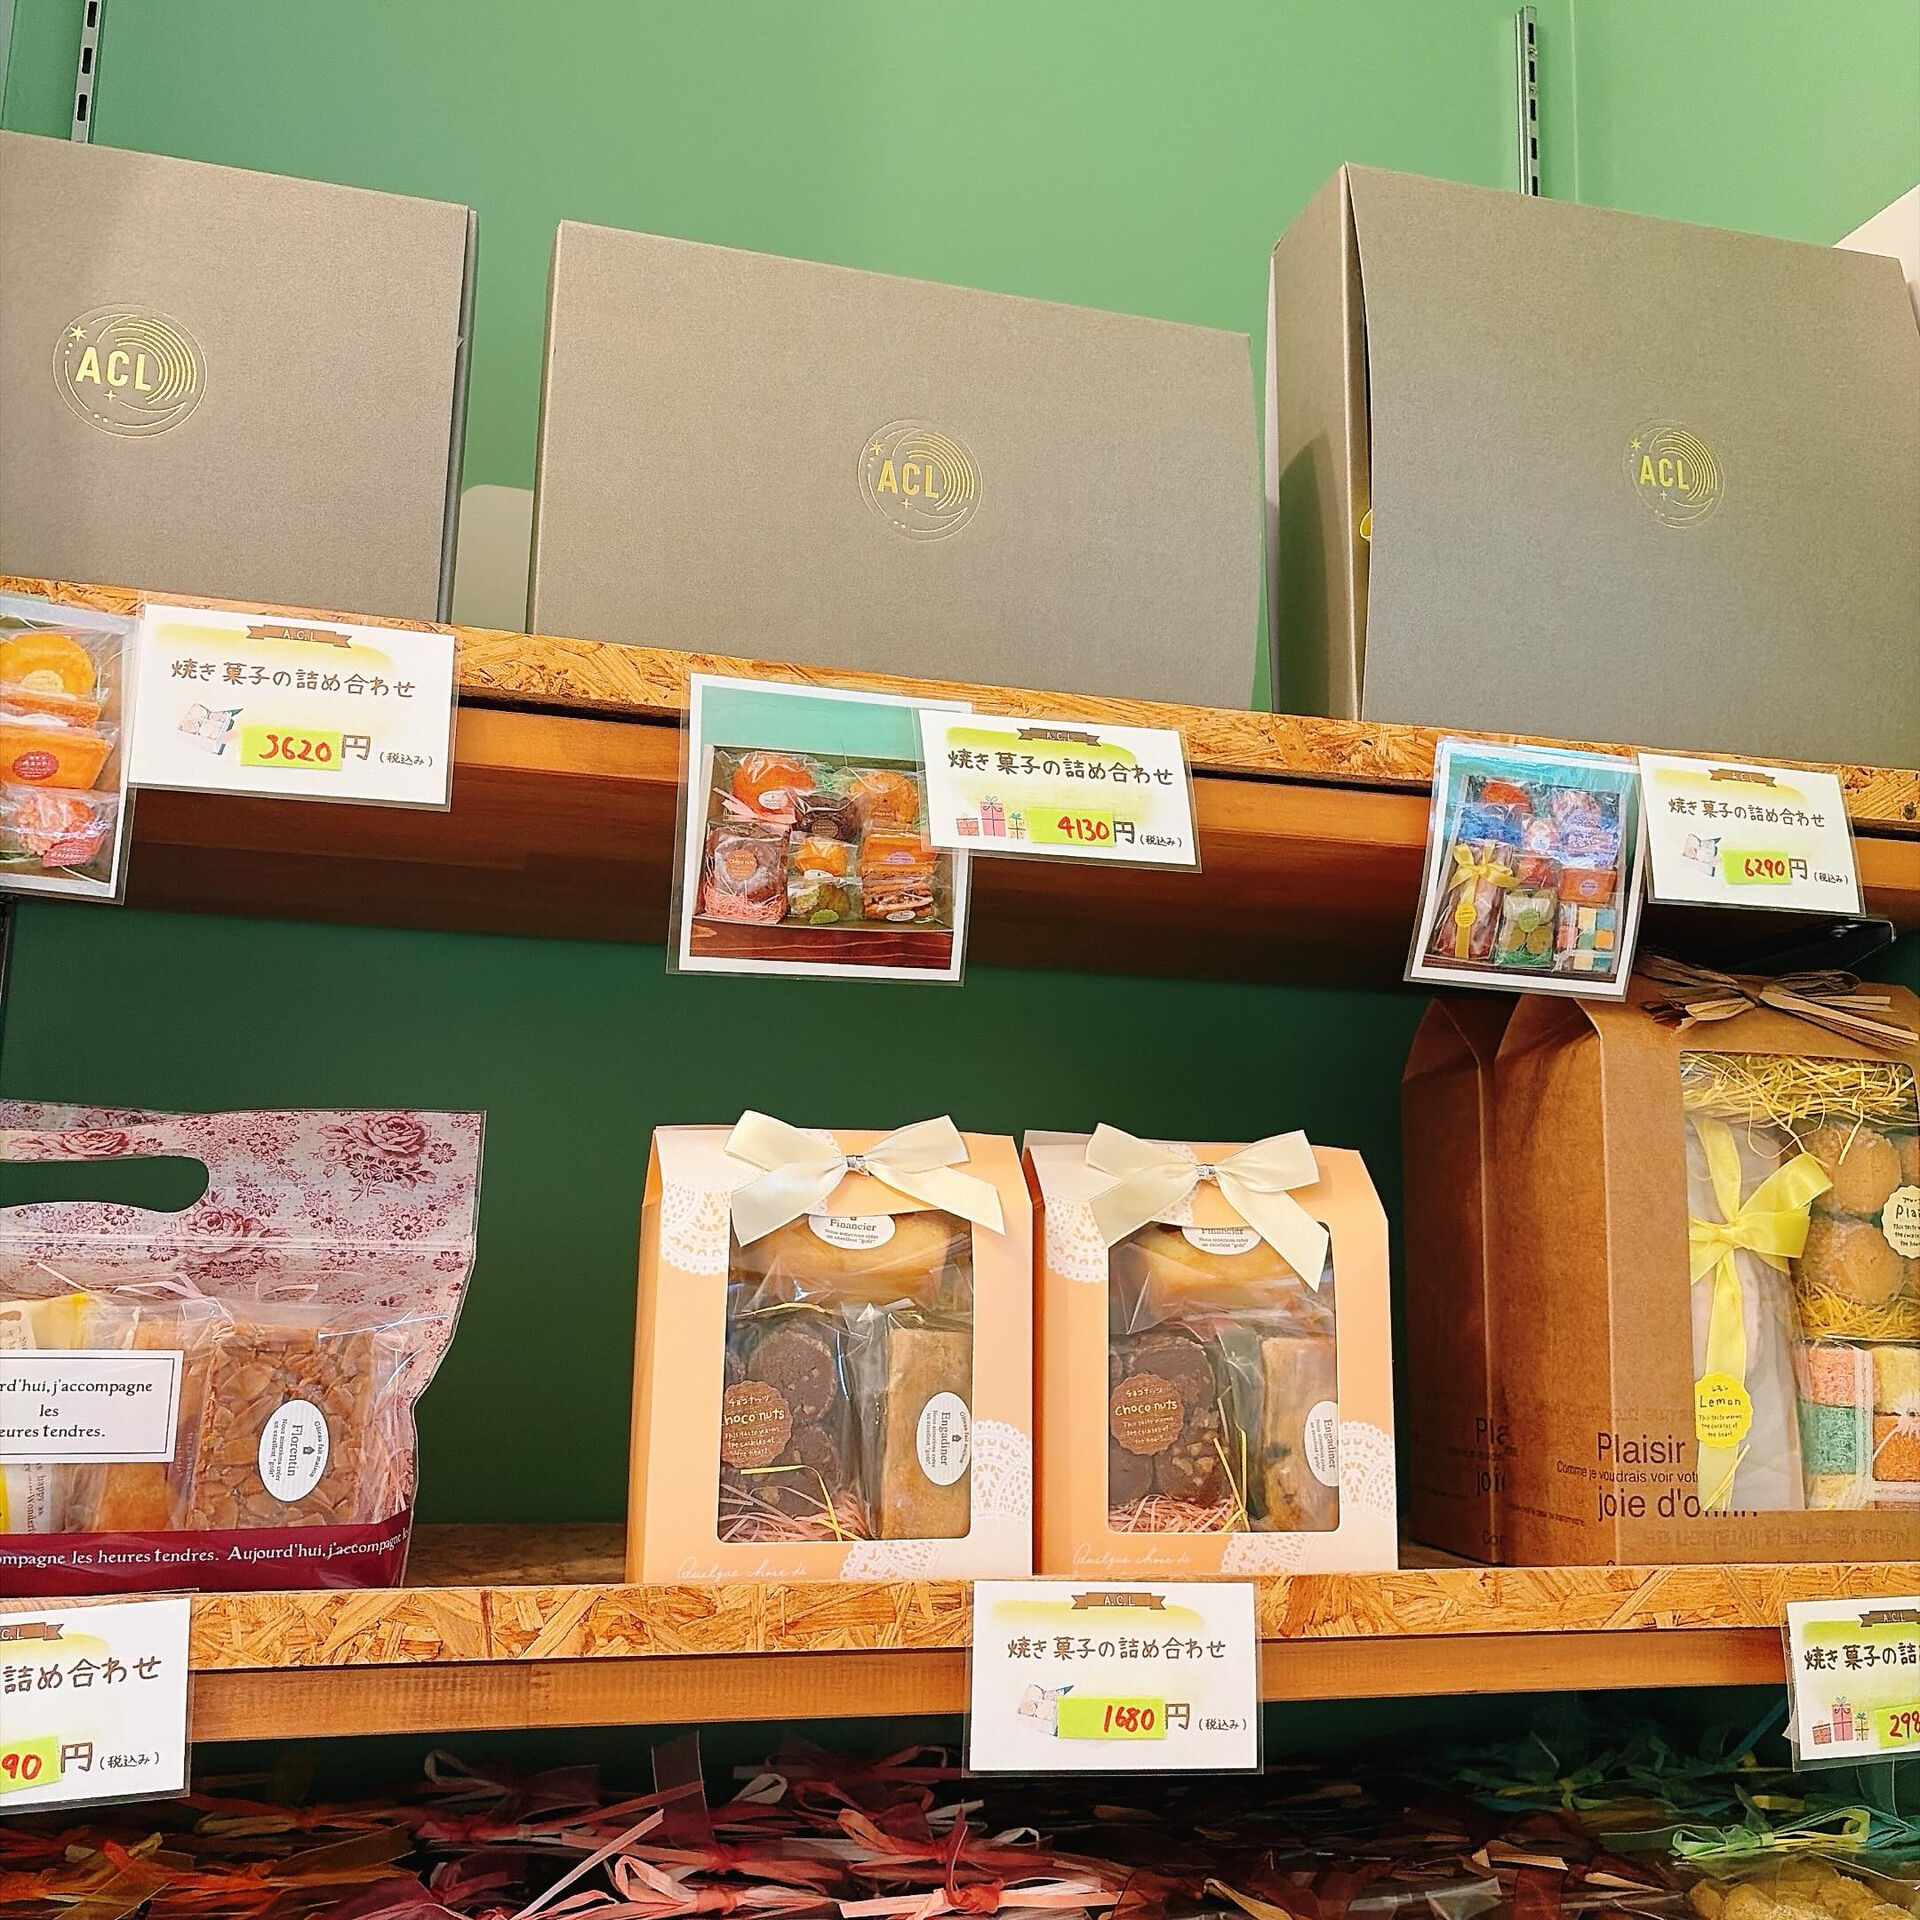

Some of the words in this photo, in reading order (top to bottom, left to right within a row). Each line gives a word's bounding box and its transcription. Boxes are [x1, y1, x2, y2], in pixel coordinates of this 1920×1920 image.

[75, 347, 151, 391] ACL
[877, 459, 939, 499] ACL
[1640, 455, 1689, 490] ACL
[830, 1219, 877, 1231] Financier
[39, 1404, 59, 1417] les
[759, 1407, 785, 1420] nuts
[1115, 1404, 1151, 1416] Choco
[1154, 1399, 1178, 1411] nuts
[1700, 1395, 1741, 1408] Lemon
[43, 1424, 106, 1437] tendres.
[939, 1412, 951, 1466] Engadiner
[1324, 1419, 1337, 1468] Engadiner
[287, 1424, 304, 1476] Florentin
[1597, 1432, 1686, 1464] Plaisir
[1556, 1460, 1587, 1477] Comme
[1599, 1470, 1647, 1482] voudrais
[1650, 1471, 1673, 1482] voir
[1598, 1485, 1646, 1522] joie
[72, 1550, 92, 1564] les
[98, 1549, 150, 1563] heures
[155, 1549, 219, 1562] tendres.
[1804, 1642, 1920, 1670] 焼き菓子の詰
